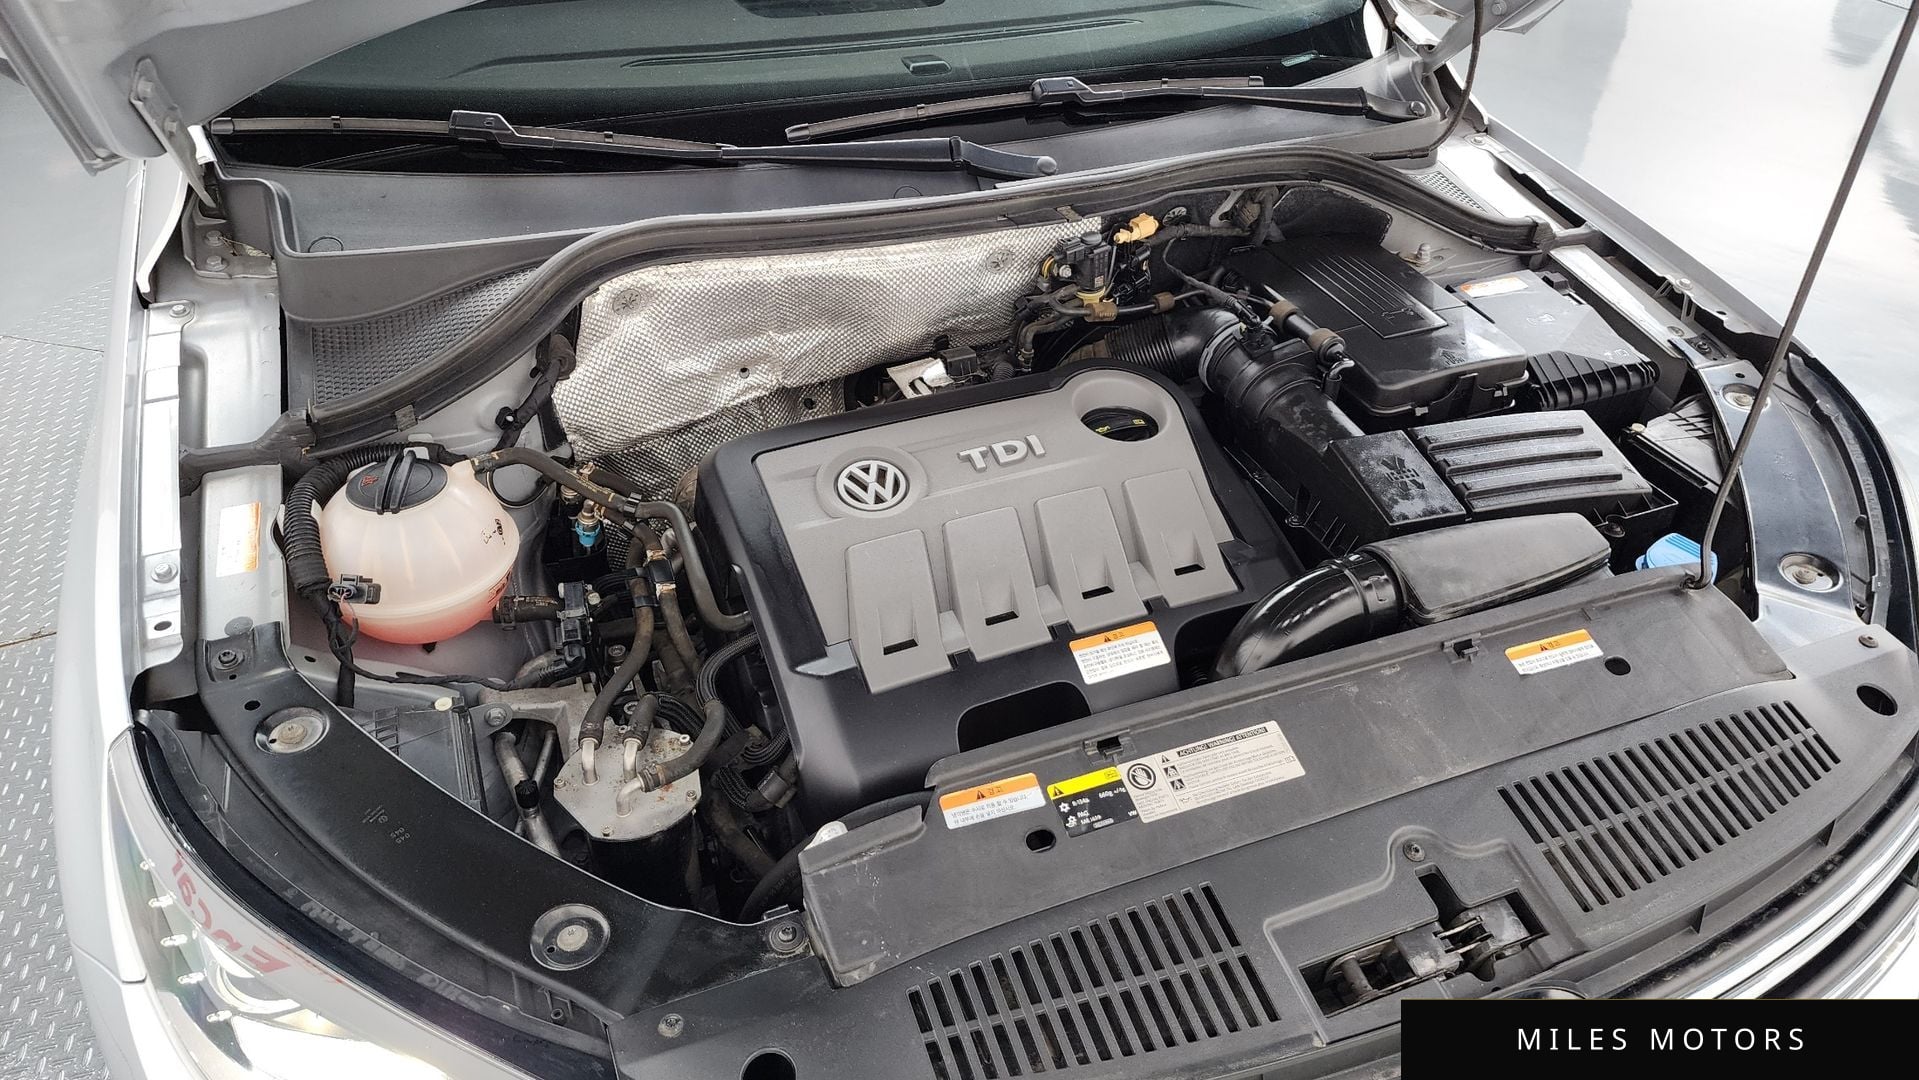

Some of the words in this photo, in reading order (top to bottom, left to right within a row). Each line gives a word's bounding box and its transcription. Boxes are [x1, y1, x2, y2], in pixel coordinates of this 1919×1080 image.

[957, 434, 1046, 472] TDI
[837, 459, 907, 511] VW
[1179, 744, 1208, 756] ACHTUNG!
[1208, 736, 1235, 748] WARNING!
